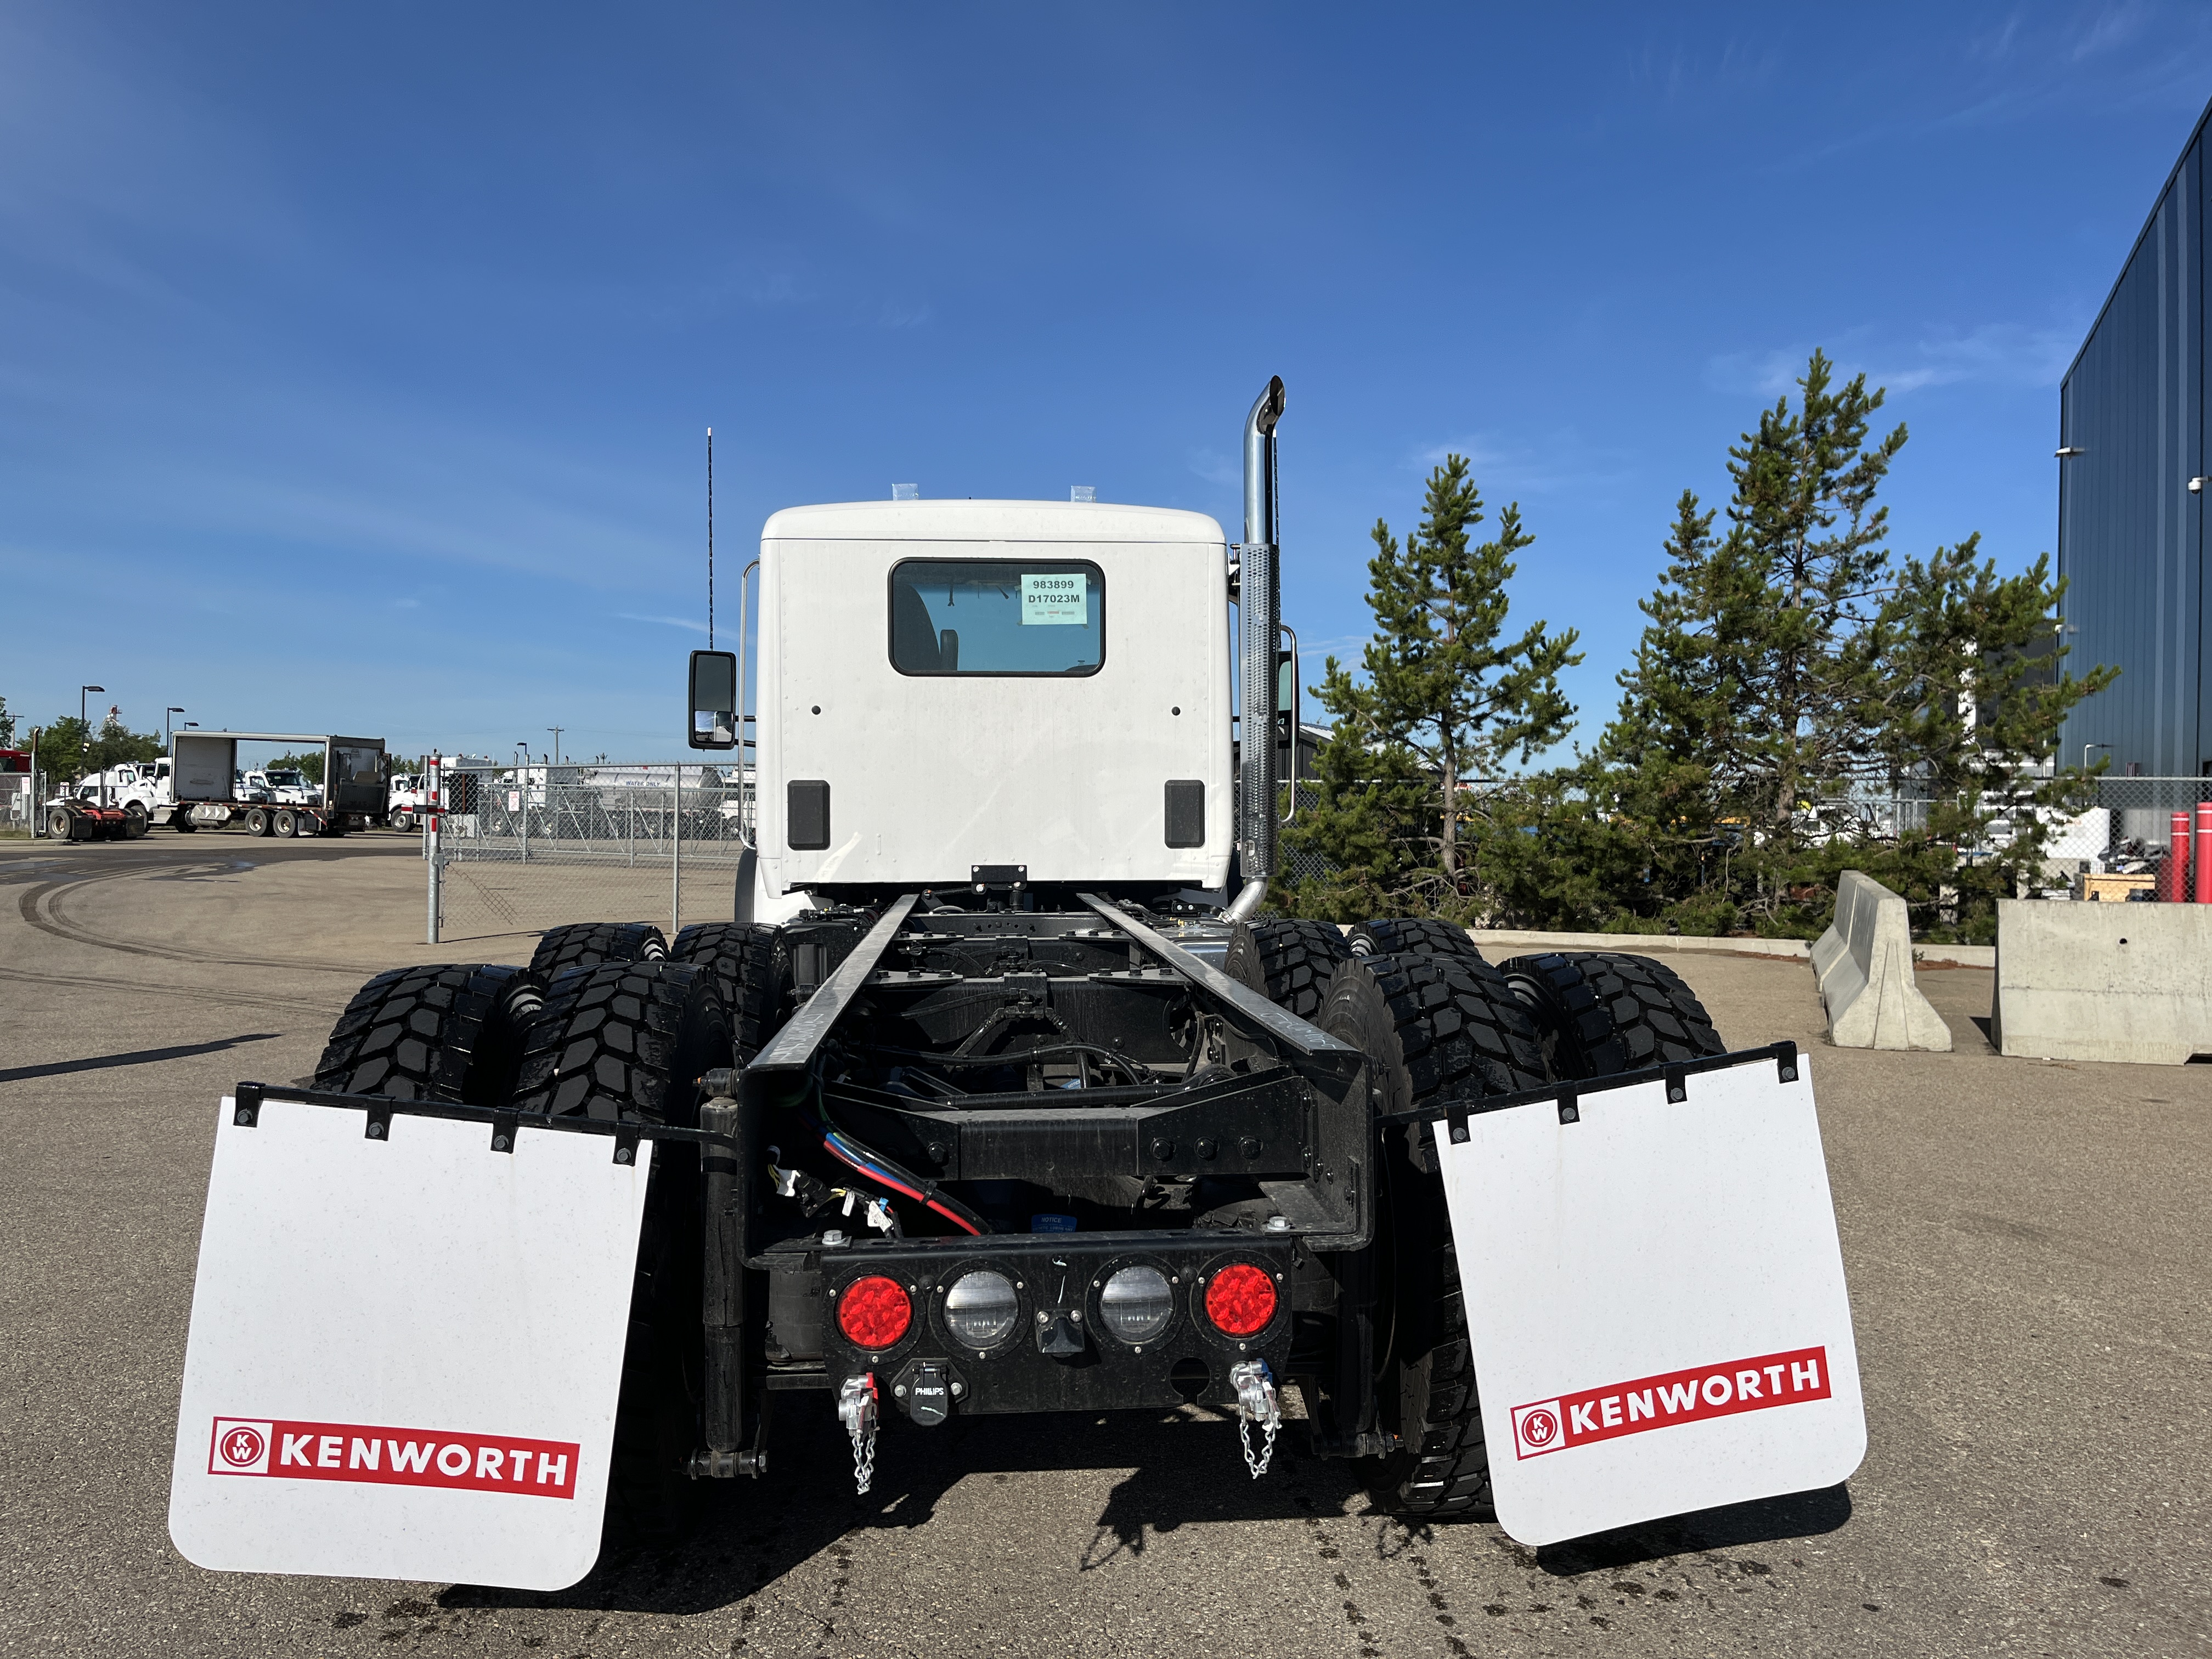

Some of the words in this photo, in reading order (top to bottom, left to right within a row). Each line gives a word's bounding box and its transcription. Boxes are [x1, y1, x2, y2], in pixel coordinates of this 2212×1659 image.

[1033, 580, 1074, 589] 983899
[1028, 595, 1080, 603] D17023M
[915, 1387, 944, 1396] PHILLIPS
[1570, 1359, 1820, 1435] KENWORTH
[280, 1433, 568, 1487] KENWORTH
